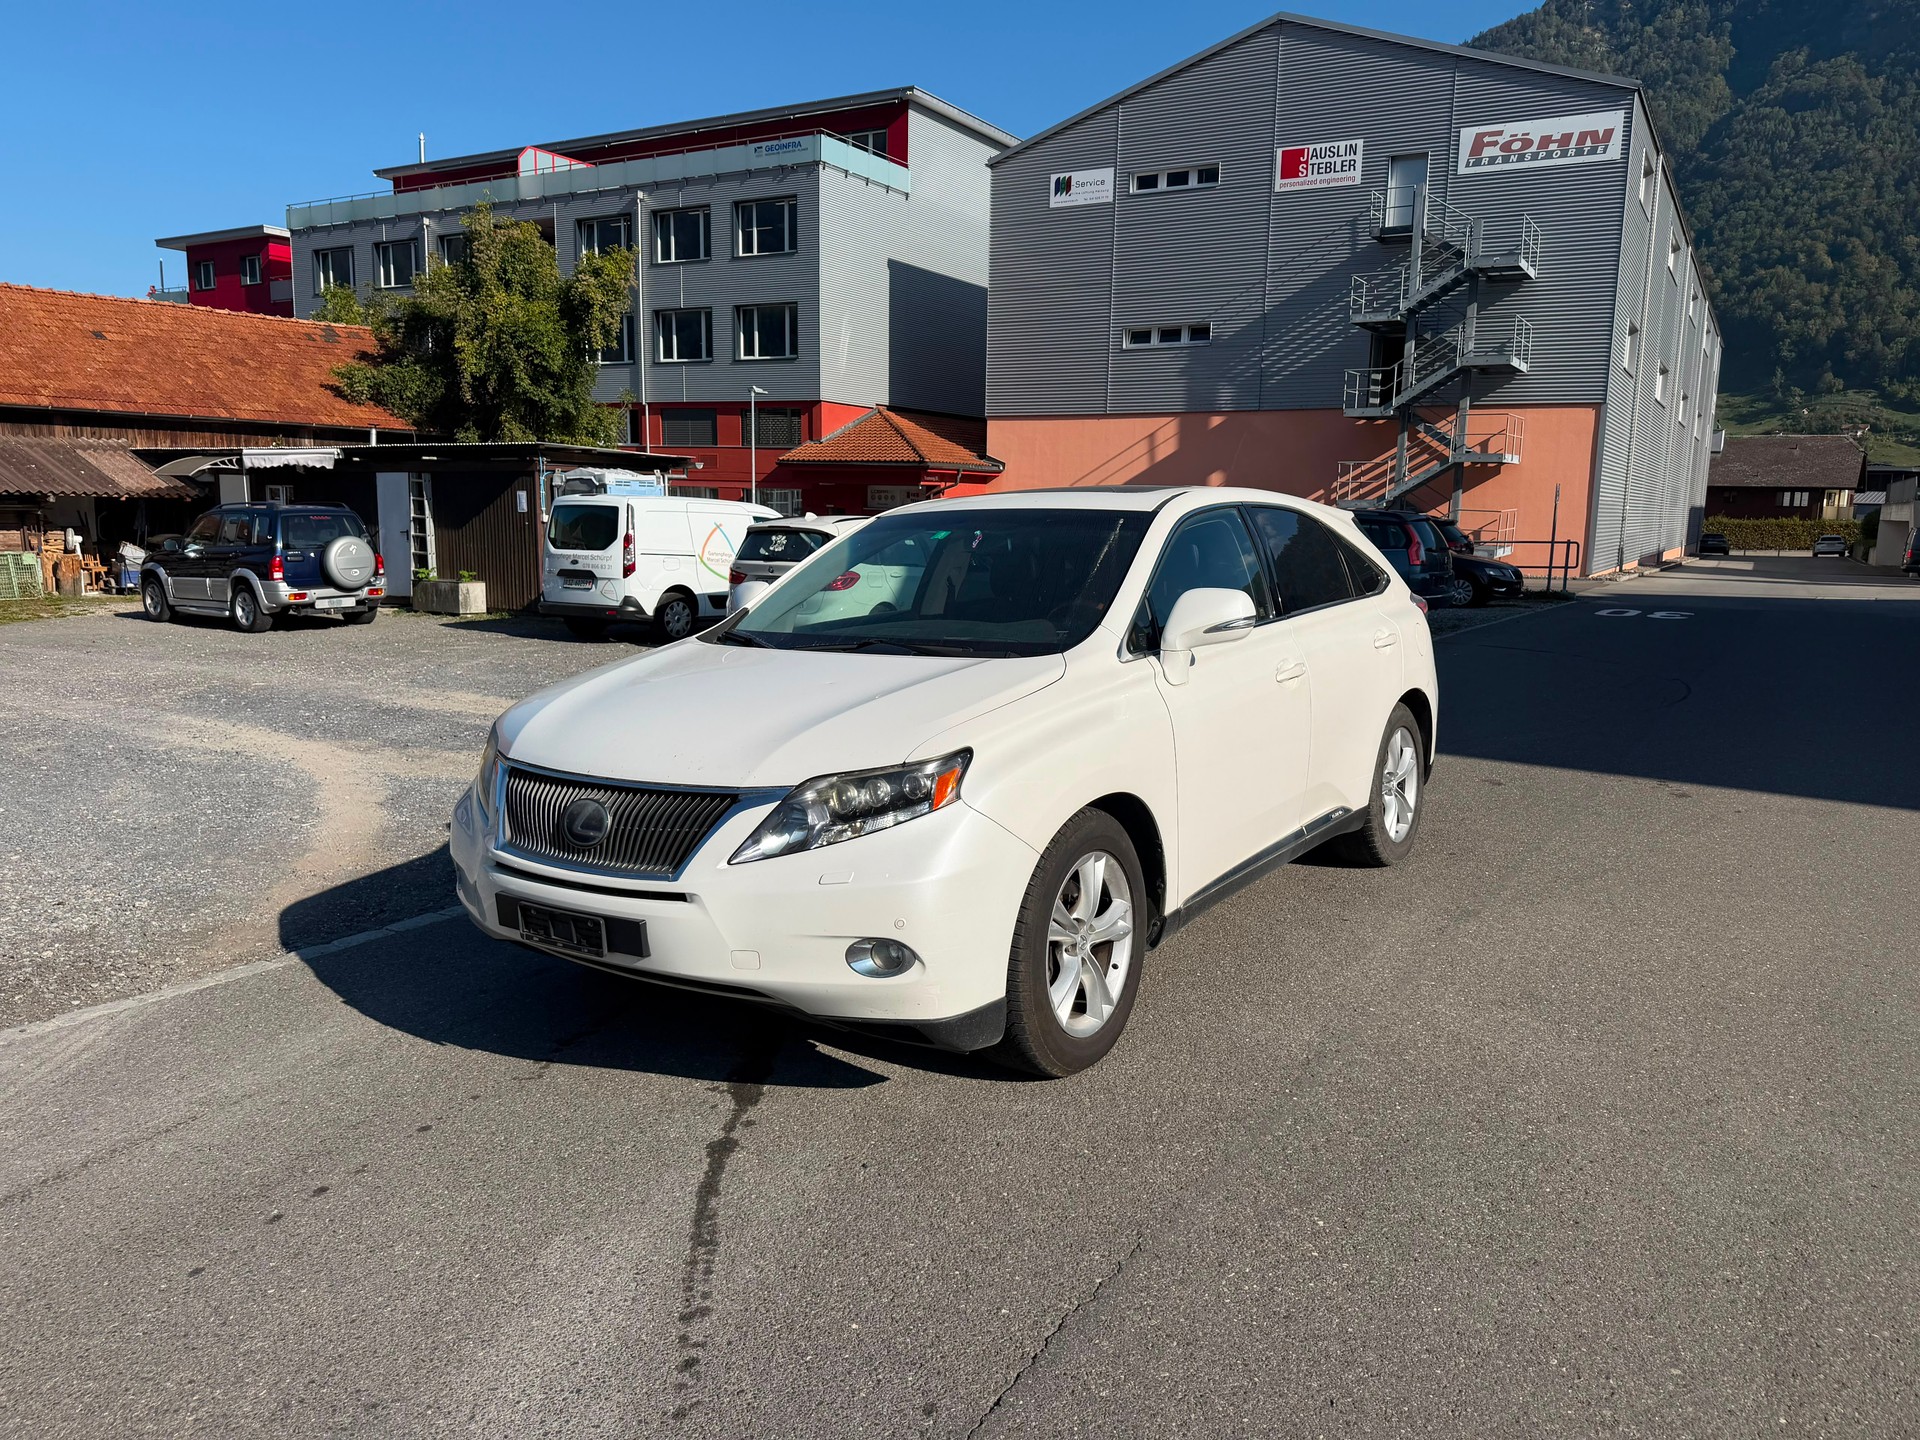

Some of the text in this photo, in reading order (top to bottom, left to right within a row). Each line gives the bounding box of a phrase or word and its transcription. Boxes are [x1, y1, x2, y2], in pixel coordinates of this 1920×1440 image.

[1468, 127, 1615, 158] FÖHN
[1300, 143, 1358, 161] JAUSLIN
[1467, 145, 1605, 167] TRANSPORTE
[1298, 159, 1357, 177] STEBLER
[1280, 175, 1356, 189] personalized engineering
